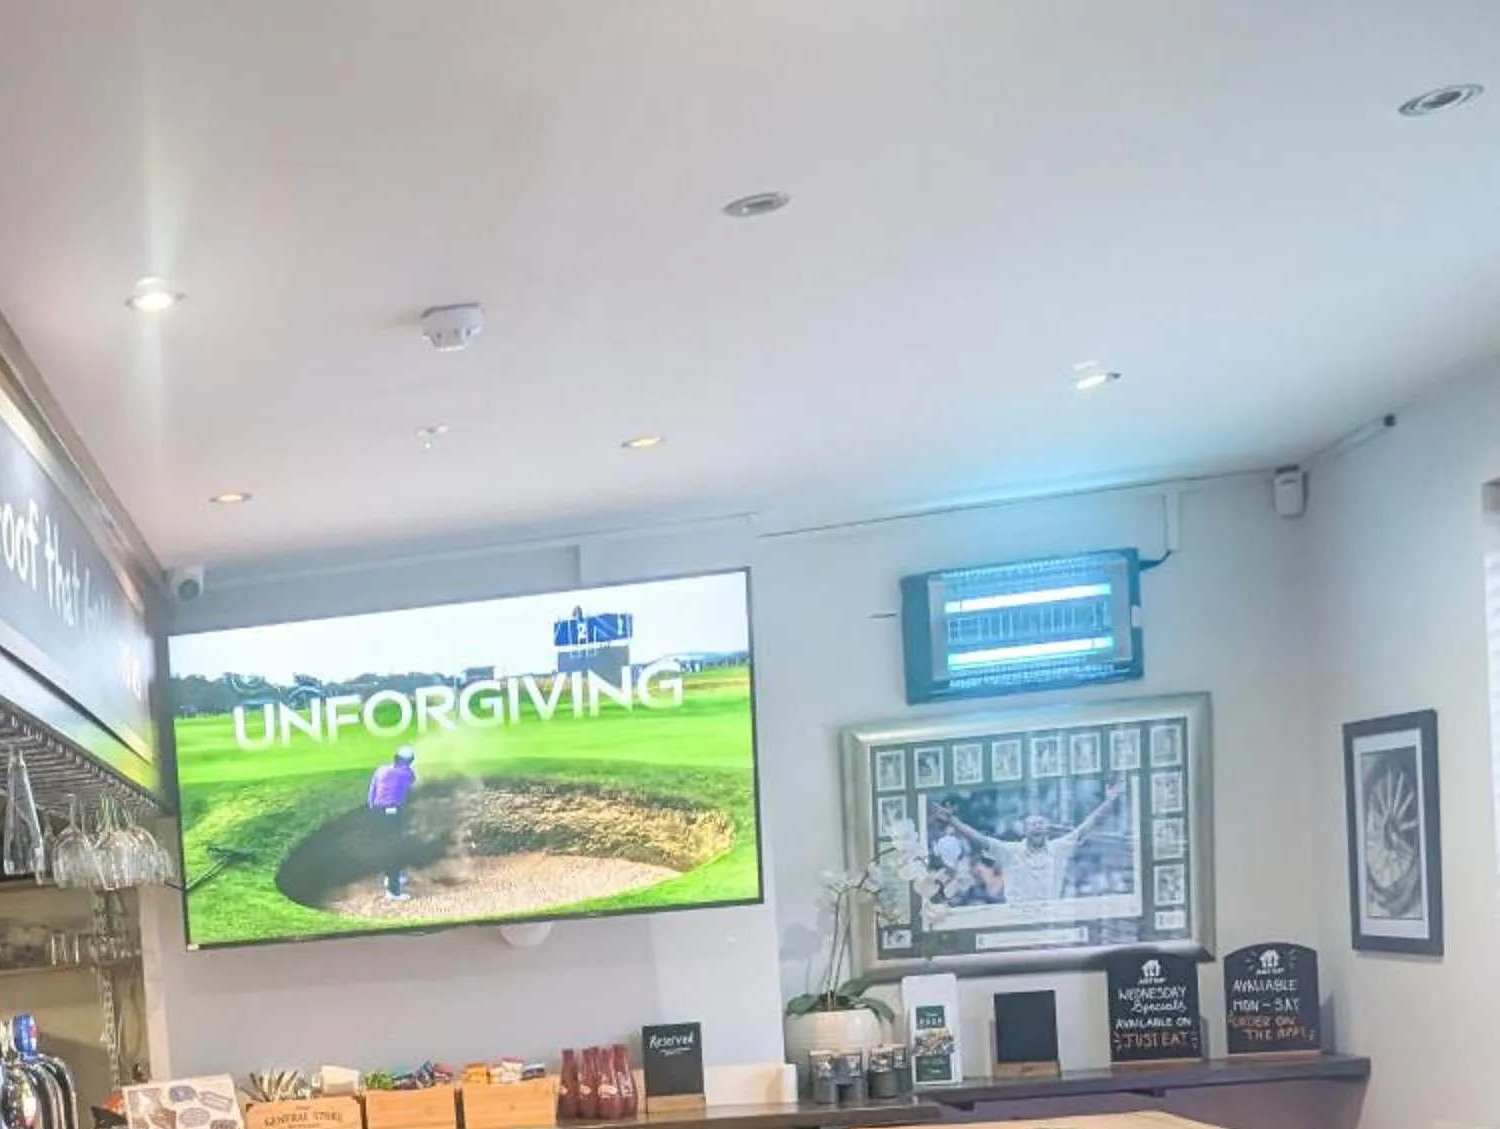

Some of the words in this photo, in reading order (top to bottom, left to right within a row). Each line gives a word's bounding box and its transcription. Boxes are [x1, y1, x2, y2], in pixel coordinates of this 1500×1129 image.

[45, 515, 81, 628] that
[232, 659, 684, 752] UNFORGIVING
[1117, 985, 1187, 1001] WEDNESDAY
[1233, 999, 1259, 1013] MON
[650, 1031, 695, 1049] Reserved
